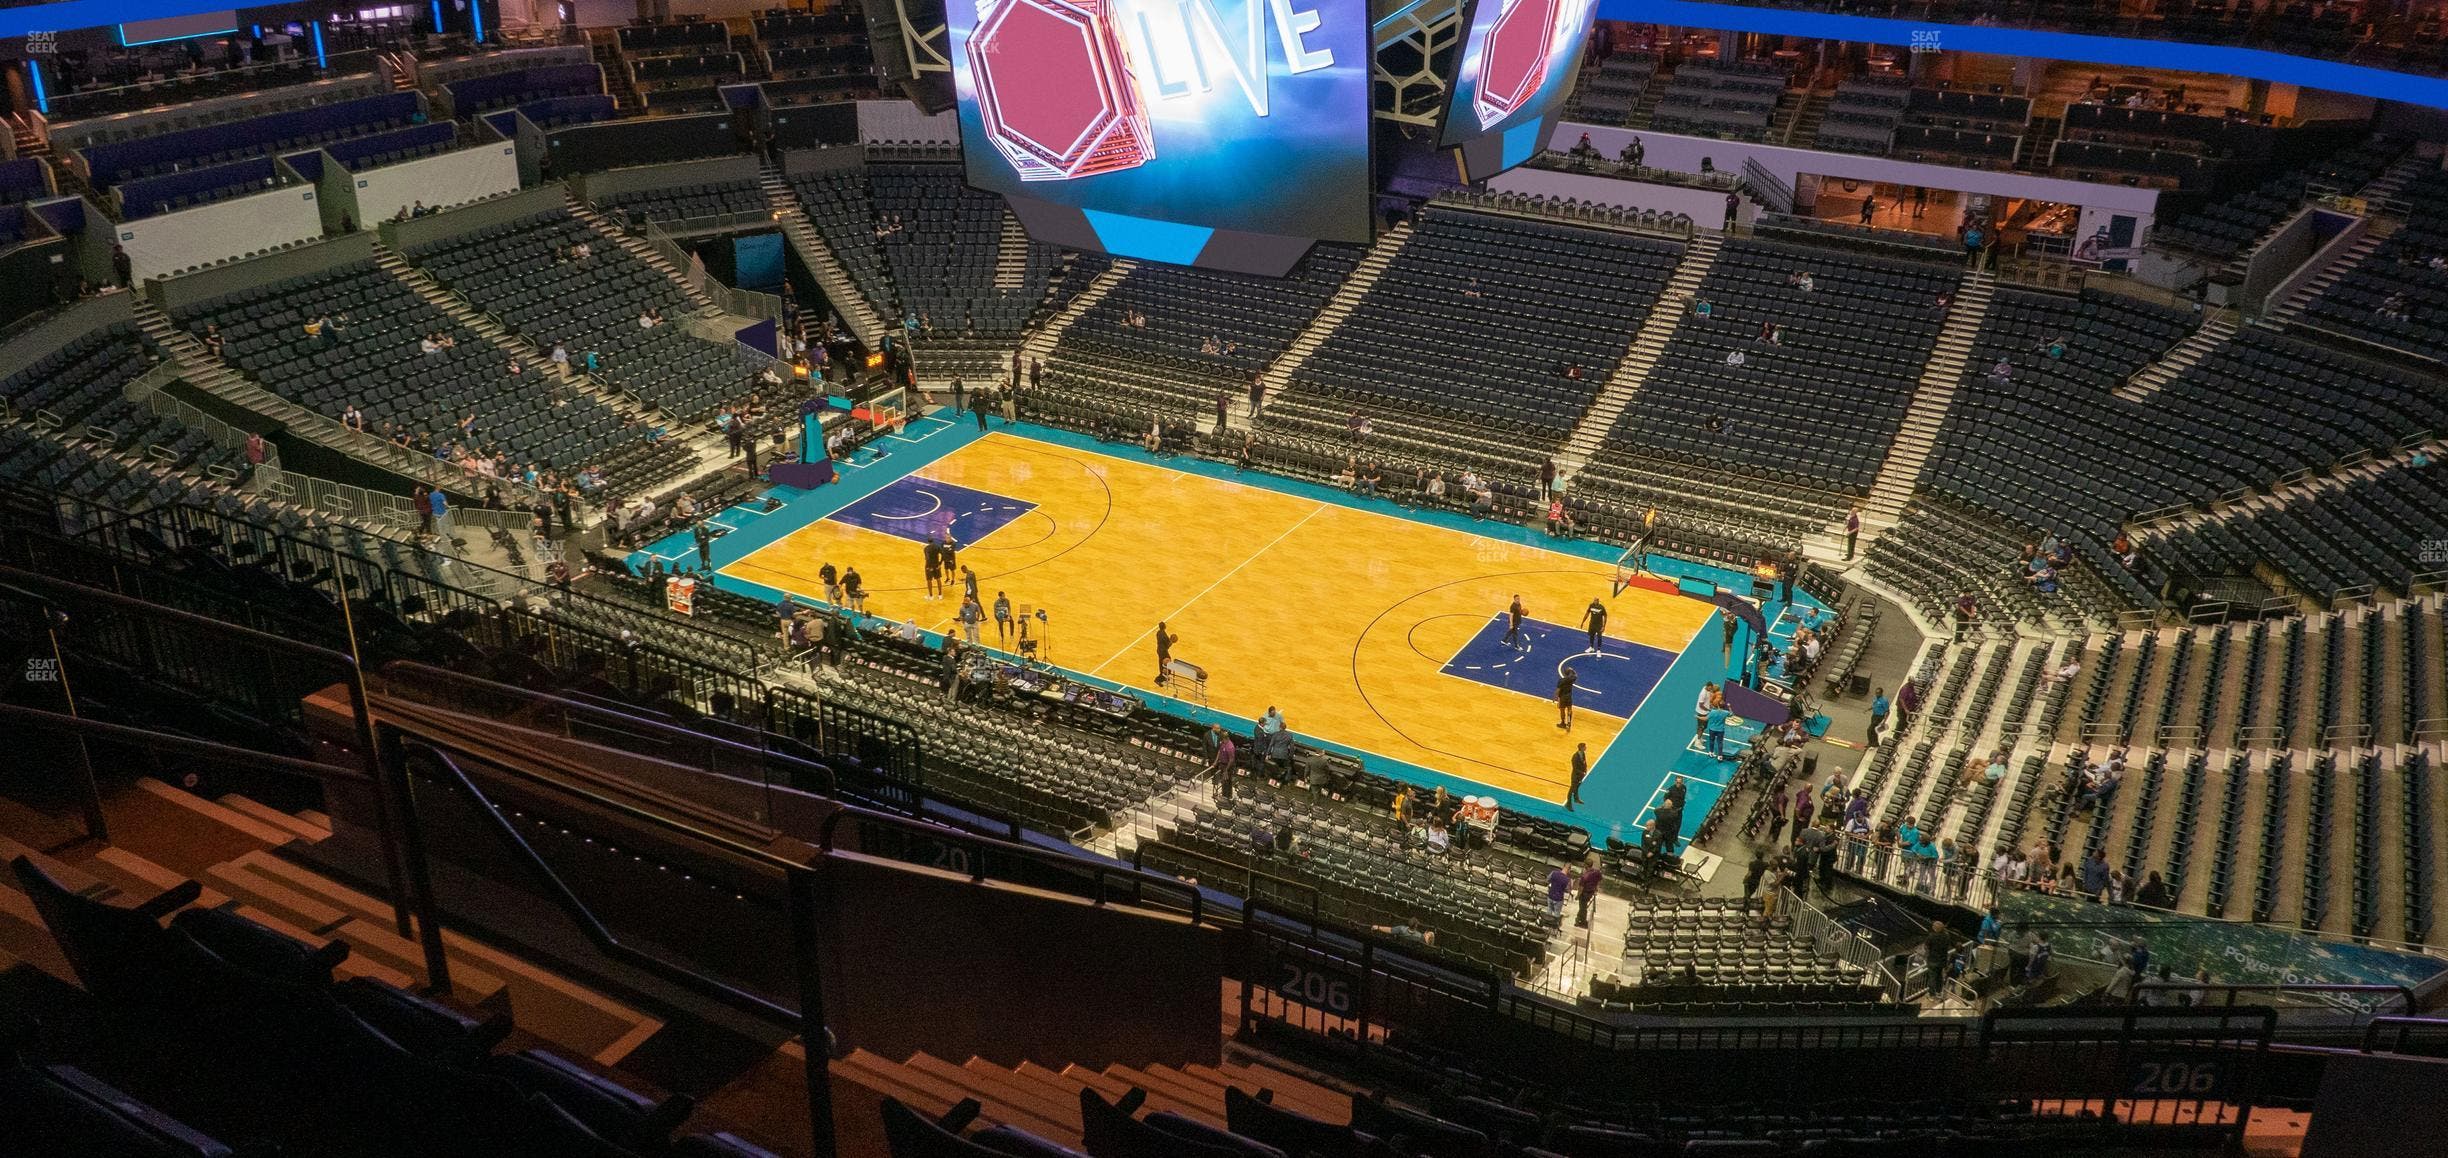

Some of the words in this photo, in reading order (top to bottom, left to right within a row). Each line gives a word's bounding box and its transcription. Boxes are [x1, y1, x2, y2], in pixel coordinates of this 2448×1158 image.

[1137, 0, 1335, 118] LIVE
[2224, 945, 2279, 974] Power
[1281, 964, 1349, 1011] 206
[2134, 1062, 2216, 1093] 206
